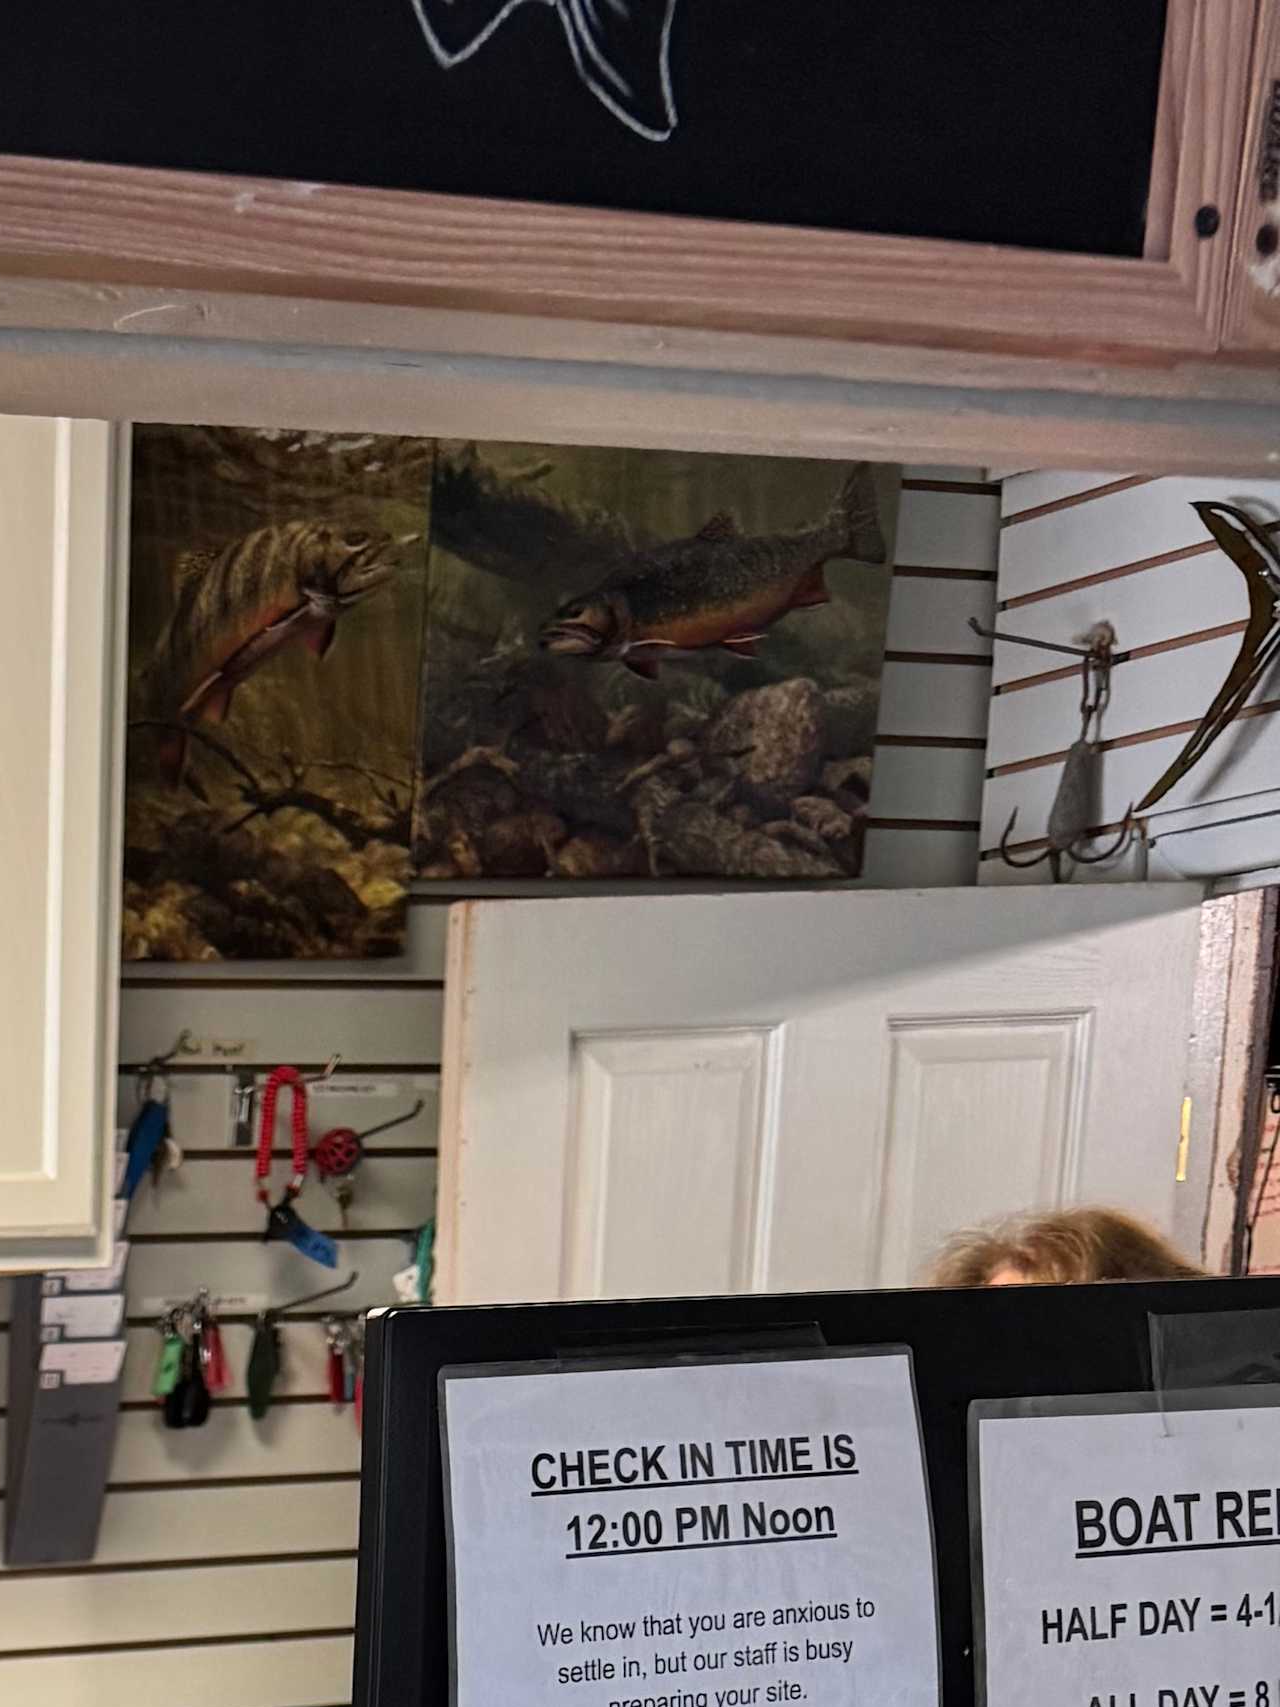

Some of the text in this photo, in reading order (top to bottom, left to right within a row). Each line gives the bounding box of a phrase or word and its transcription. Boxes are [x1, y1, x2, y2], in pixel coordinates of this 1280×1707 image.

[532, 1434, 856, 1490] CHECK IN TIME IS
[566, 1501, 835, 1551] 12:00 PM Noon
[1075, 1488, 1280, 1549] BOAT RE
[537, 1598, 875, 1646] We know that you are anxious to
[1042, 1591, 1280, 1644] HALF DAY 4-1
[558, 1638, 853, 1684] settle in, but our staff is busy
[766, 1680, 807, 1702] site.
